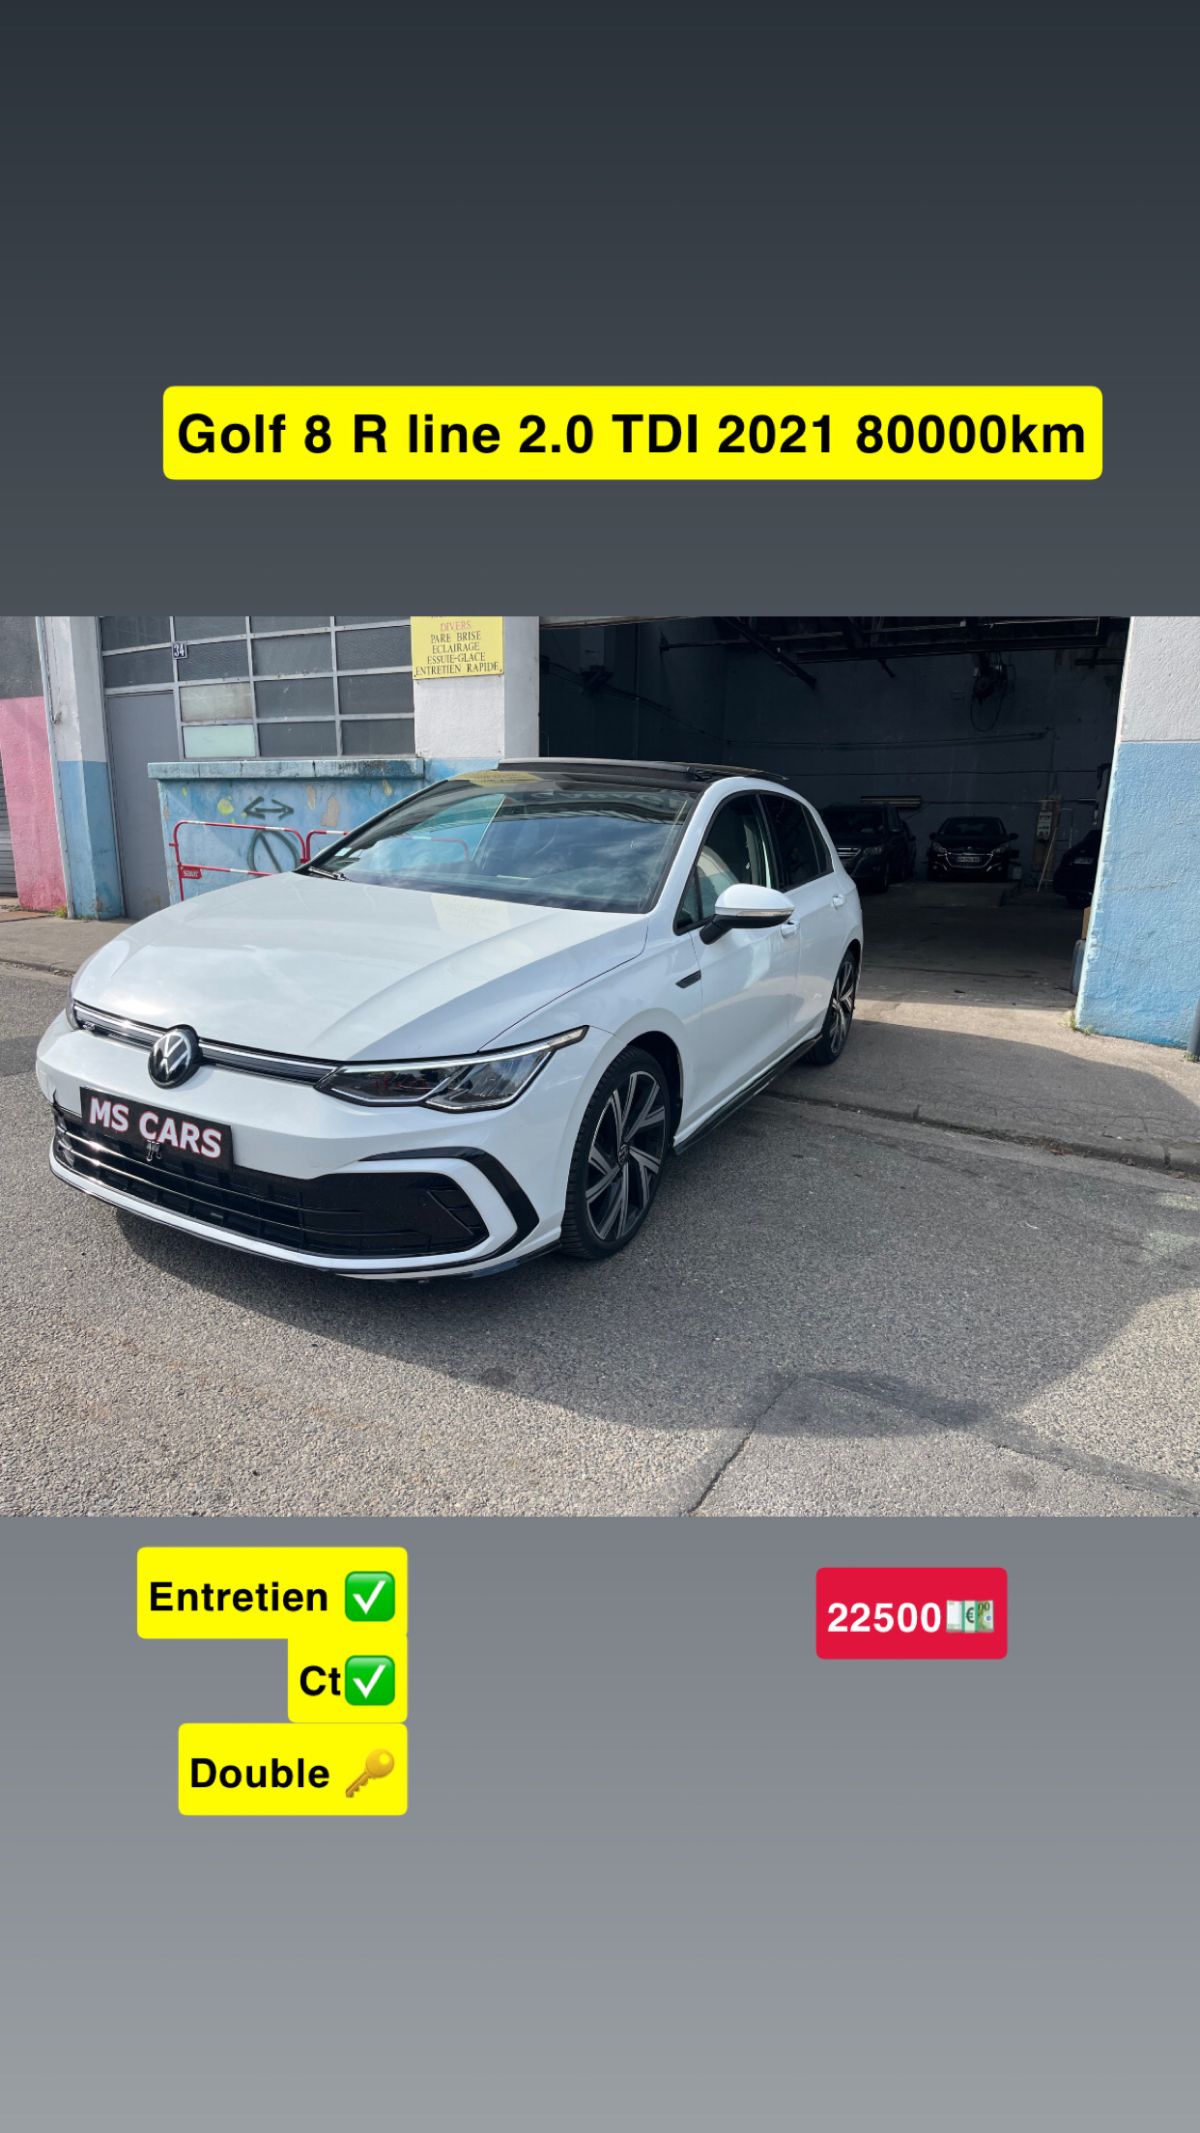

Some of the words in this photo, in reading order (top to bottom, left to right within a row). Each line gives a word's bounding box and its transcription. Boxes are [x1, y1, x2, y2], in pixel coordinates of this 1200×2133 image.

[440, 620, 472, 631] DIVERS
[430, 633, 451, 644] PARE
[457, 631, 481, 641] BRISE
[173, 643, 185, 657] 34
[432, 642, 480, 654] ECLAIRAGE
[427, 652, 486, 664] ESSUIE-GLACE
[416, 665, 461, 675] ENTRETIEN
[467, 662, 499, 672] RAPIDE
[89, 1096, 130, 1132] MS
[139, 1110, 222, 1159] CARS
